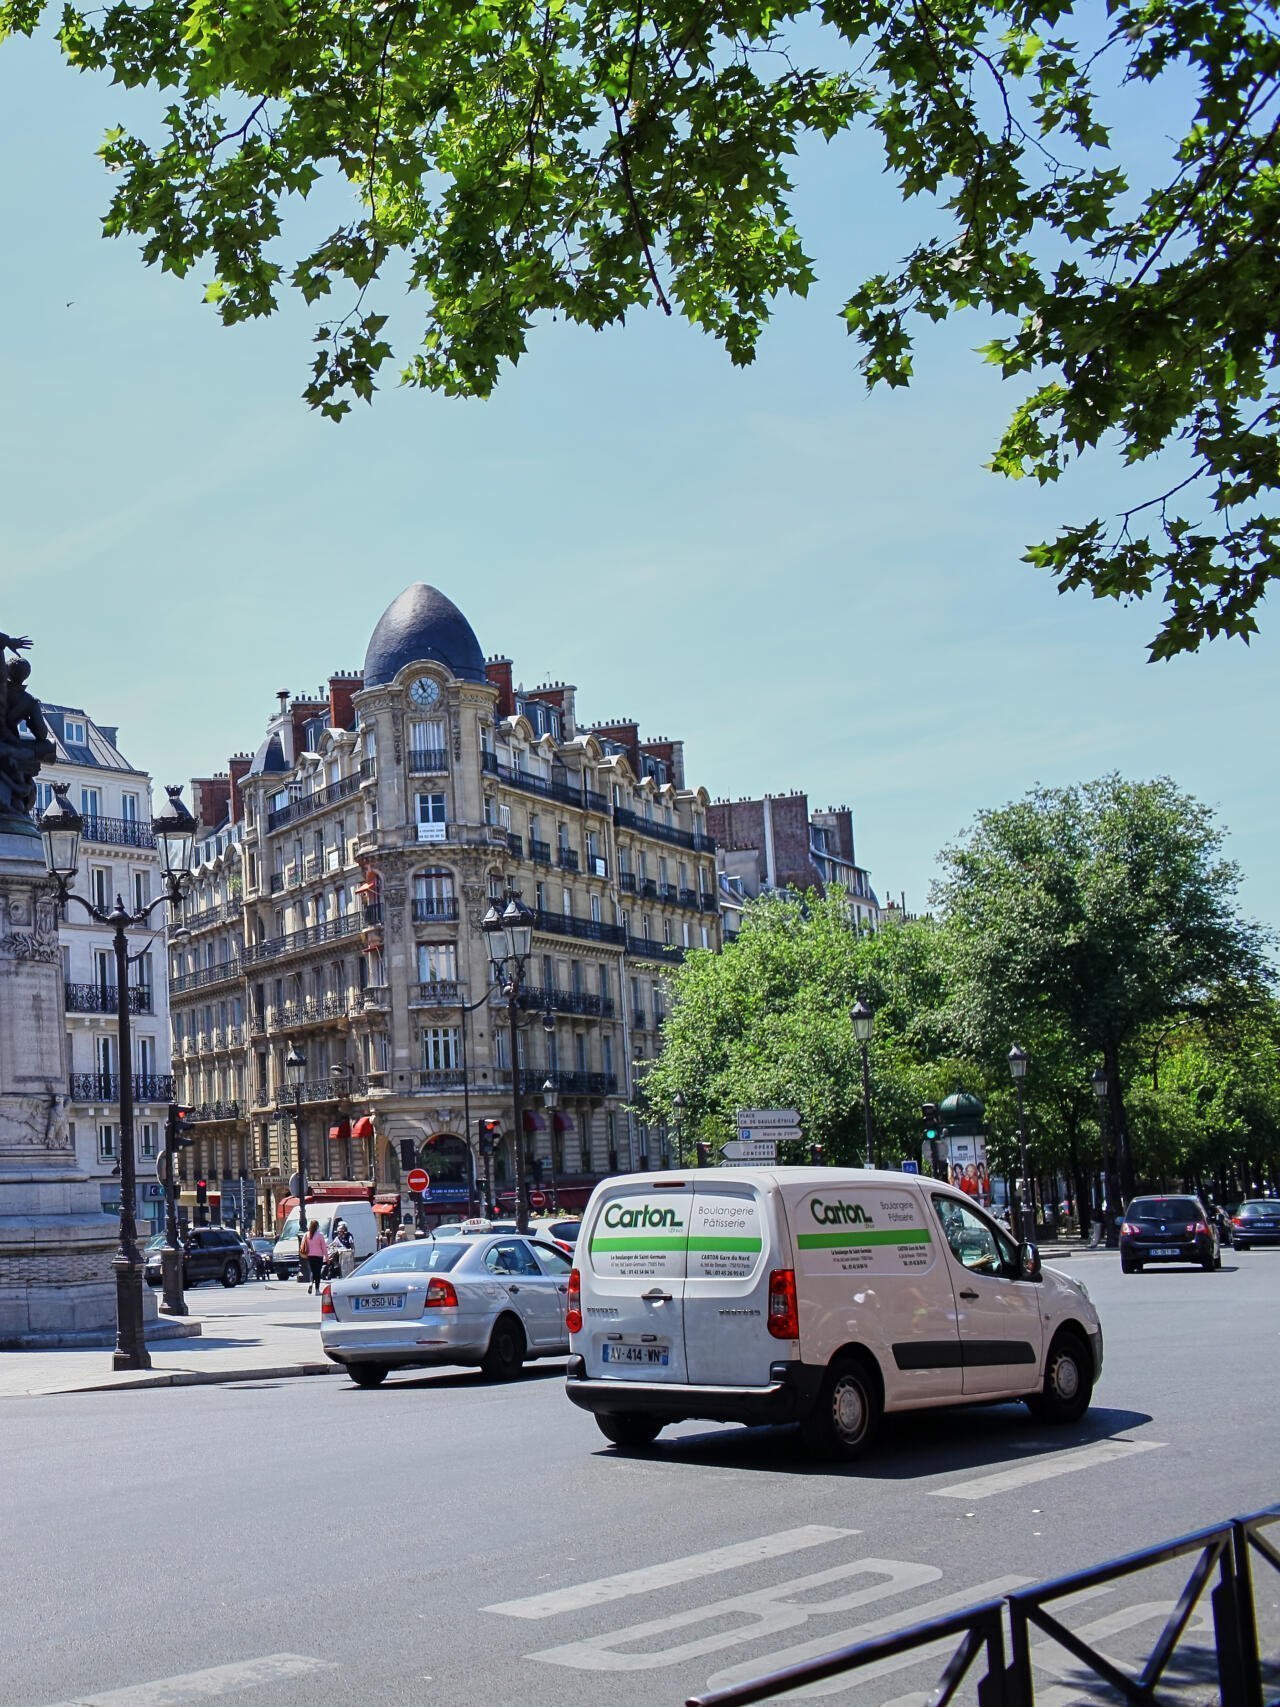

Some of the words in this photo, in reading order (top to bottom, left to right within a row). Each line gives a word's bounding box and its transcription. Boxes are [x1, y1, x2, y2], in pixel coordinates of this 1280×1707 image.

[605, 1203, 683, 1228] Carton
[698, 1206, 754, 1217] Boulangerie
[810, 1198, 873, 1225] Carton
[703, 1218, 746, 1228] Pâtisserie
